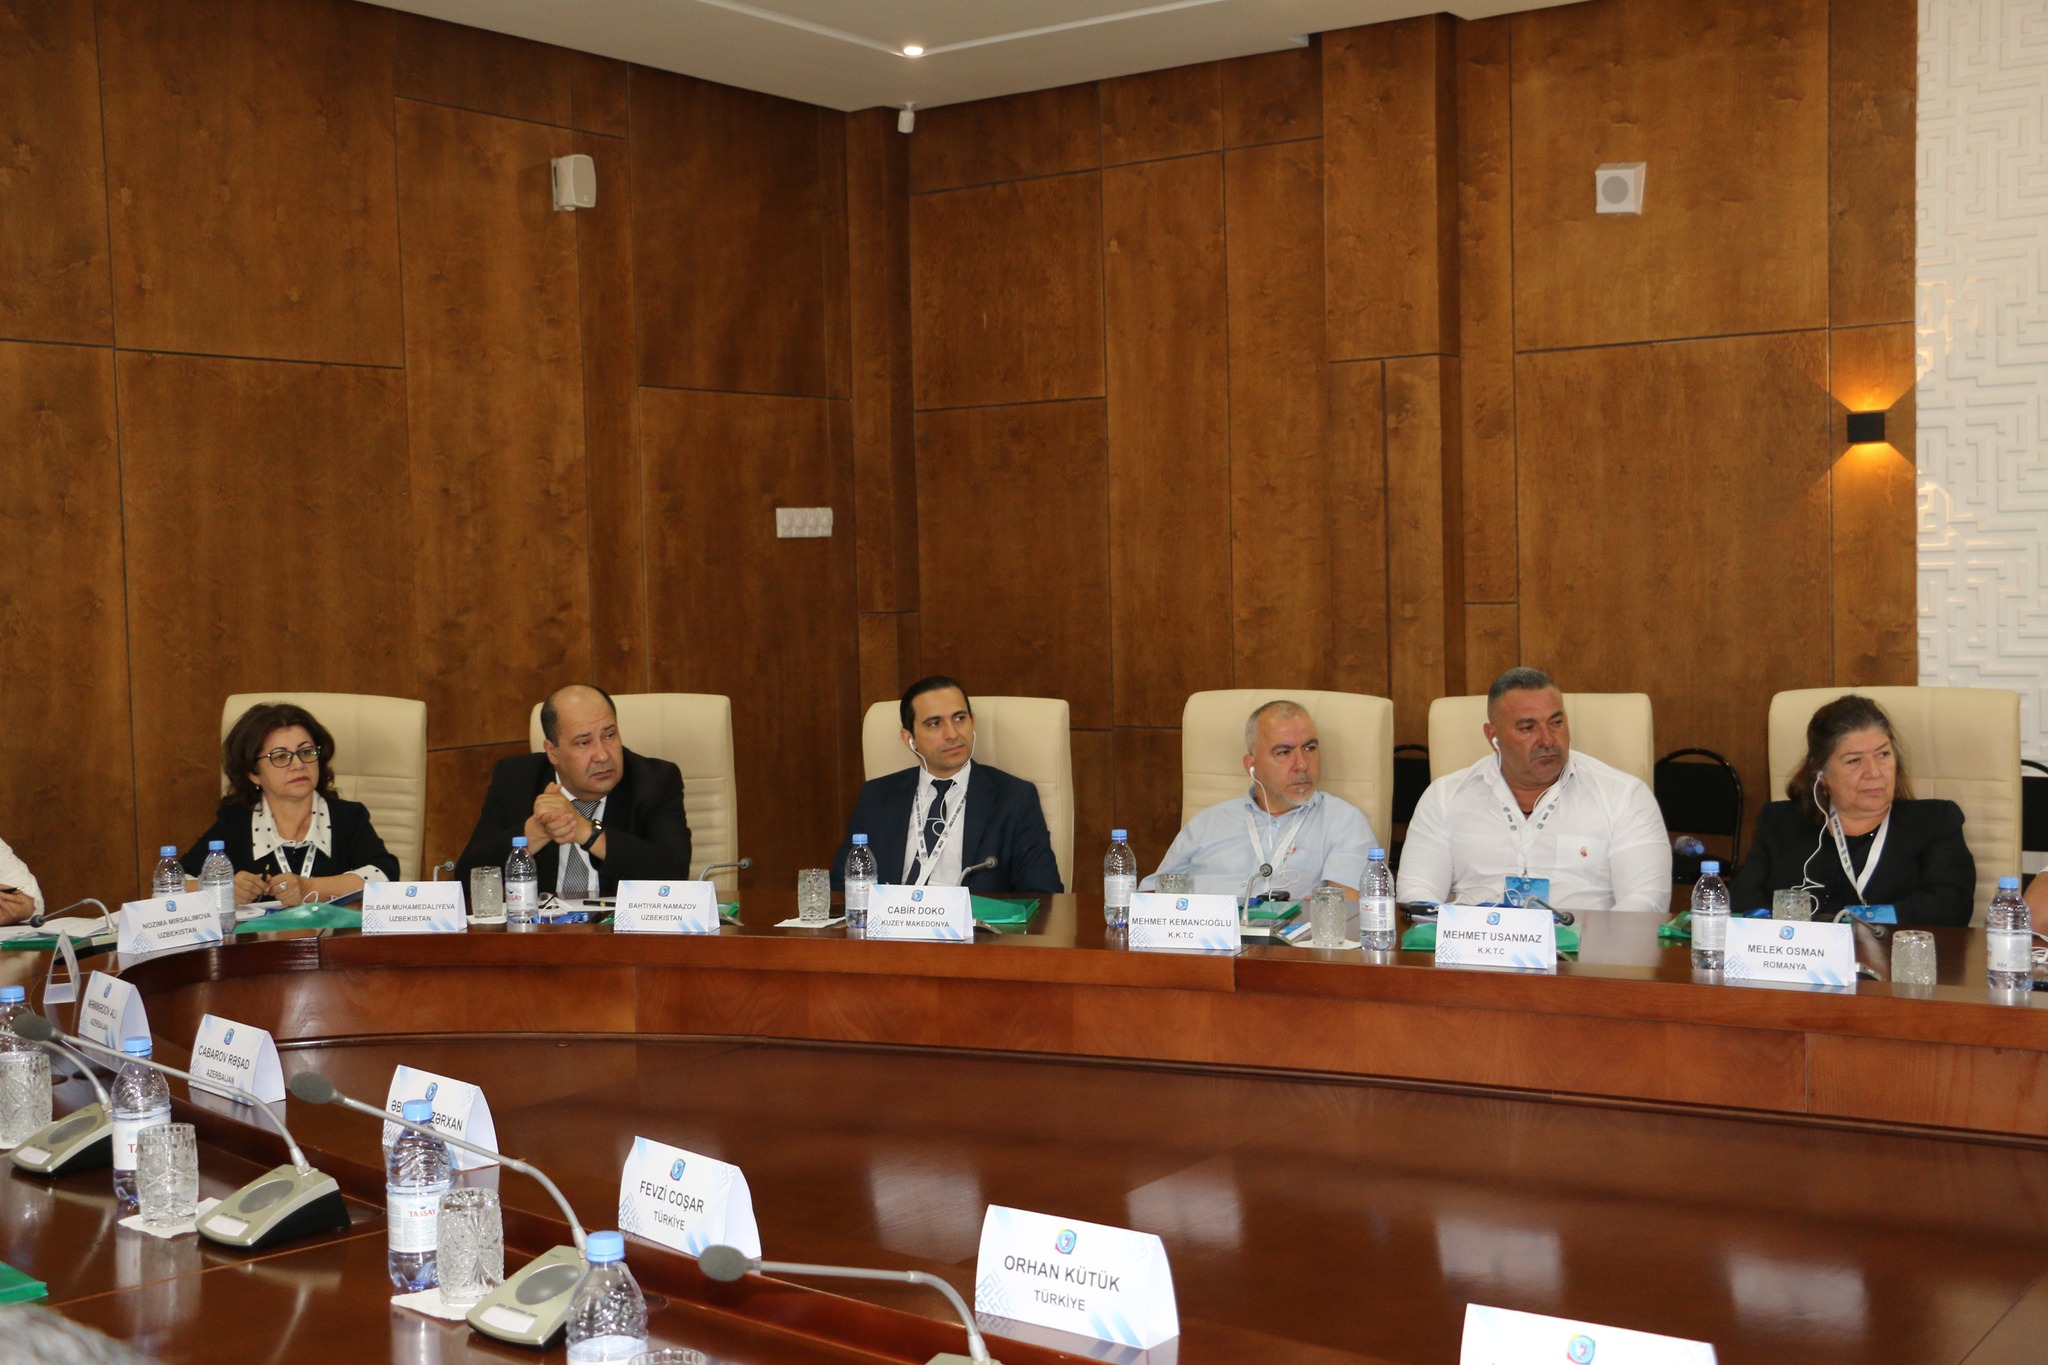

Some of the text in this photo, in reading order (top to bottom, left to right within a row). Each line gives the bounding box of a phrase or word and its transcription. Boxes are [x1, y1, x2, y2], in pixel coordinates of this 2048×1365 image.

[392, 903, 456, 911] MUHAMEDALIYEVA
[887, 904, 945, 916] CABİR DOKO
[142, 912, 212, 930] NOZIMA MIRSALIMOVA
[881, 919, 950, 928] KUZEY MAKEDONYA
[1131, 917, 1232, 927] MEHMET KEMANCIOĞLU
[157, 926, 198, 940] UZBEKISTAN
[1443, 929, 1542, 944] MEHMET USANMAZ
[1747, 944, 1825, 957] MELEK OSMAN
[1763, 960, 1807, 971] ROMANYA
[198, 1045, 250, 1070] CABAROV RƏŞAD
[640, 1180, 704, 1214] FEVZİ COŞAR
[408, 1208, 437, 1218] TASSAY
[653, 1209, 686, 1231] TÜRKİYE
[1004, 1254, 1120, 1292] ORHAN KÜTÜK
[1034, 1288, 1086, 1312] TÜRKİYE
